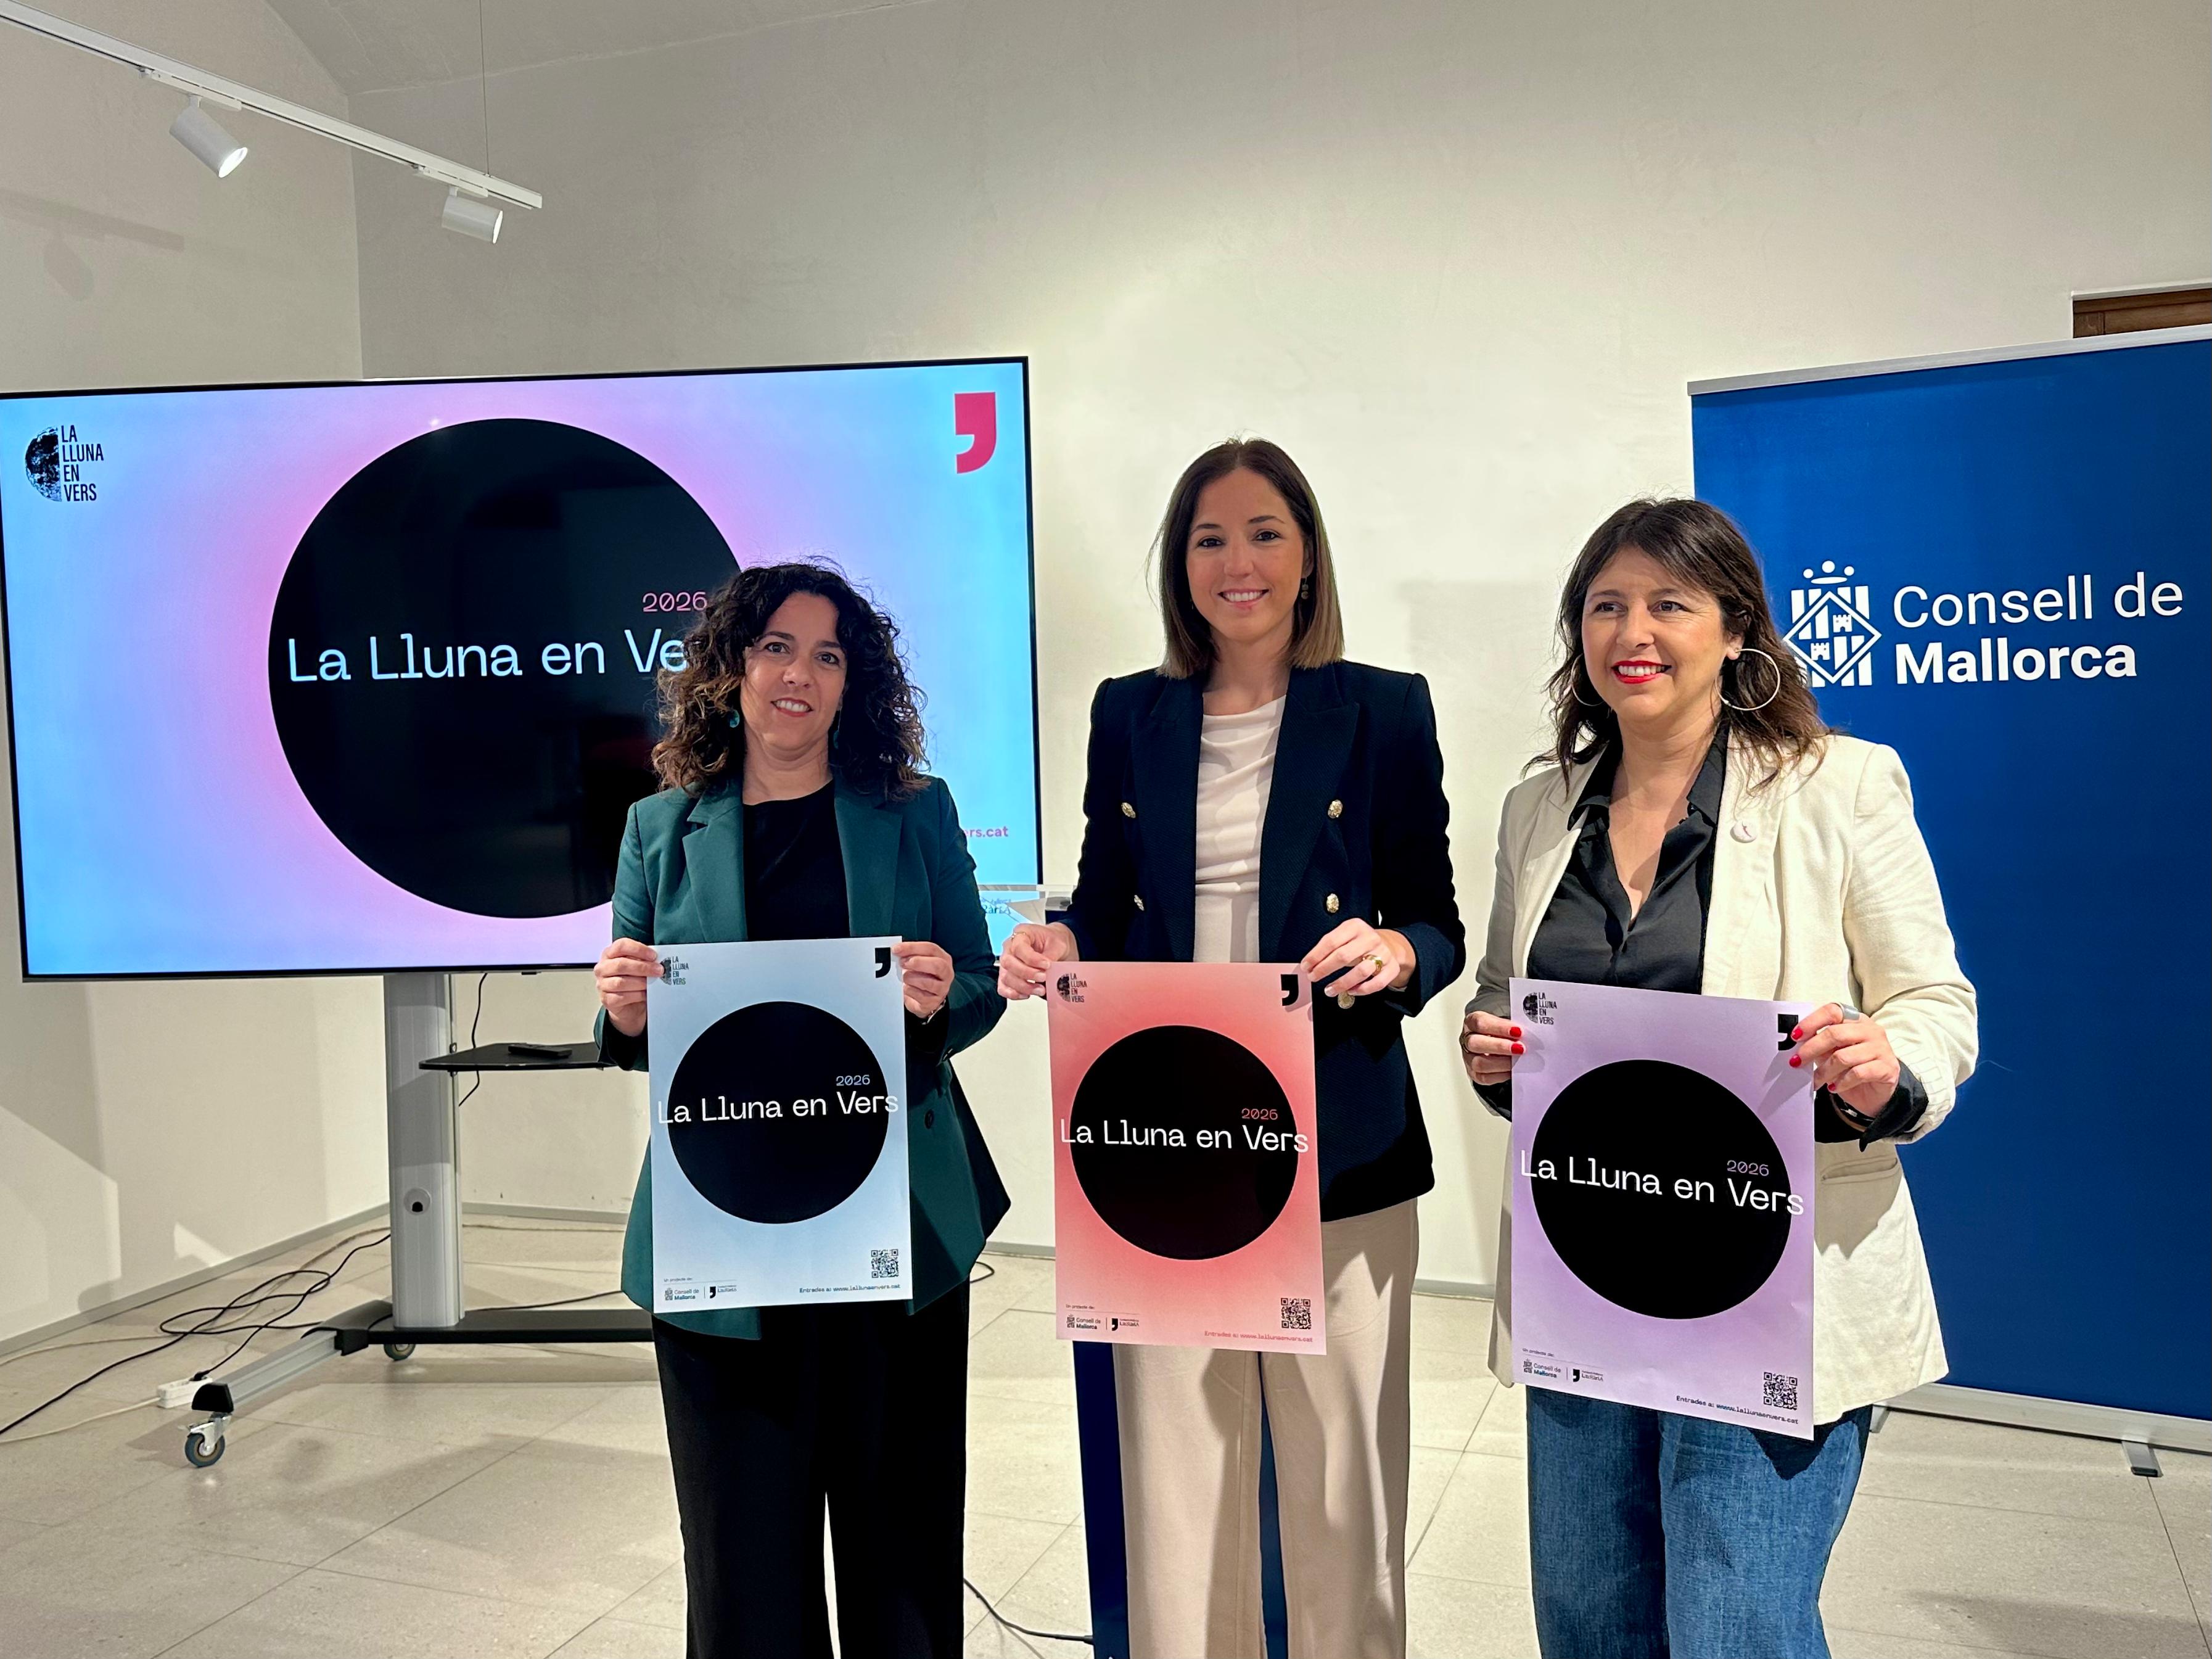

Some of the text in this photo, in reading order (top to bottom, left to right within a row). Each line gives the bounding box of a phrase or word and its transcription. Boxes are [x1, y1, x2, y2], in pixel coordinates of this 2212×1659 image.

[61, 424, 78, 443] LA
[62, 443, 104, 463] LLUNA
[64, 464, 80, 482] EN
[64, 484, 97, 502] VERS
[642, 591, 709, 612] 2026
[1893, 571, 2184, 628] Consell de
[288, 628, 689, 683] La Lluna en Ve
[1896, 636, 2137, 685] Mallorca
[1070, 972, 1077, 980] LA
[1071, 987, 1078, 995] EN
[1539, 992, 1546, 1000] LA
[1539, 1008, 1547, 1016] EN
[1539, 1016, 1554, 1025] VERS
[836, 1074, 871, 1087] 2026
[657, 1090, 899, 1124] La Lluna en Vers
[1241, 1108, 1278, 1121] 2026
[1060, 1118, 1309, 1153] La Lluna en Vers
[1727, 1159, 1770, 1177] 2026
[1521, 1150, 1804, 1216] La Lluna en Vers
[1676, 1395, 1706, 1406] Entrades
